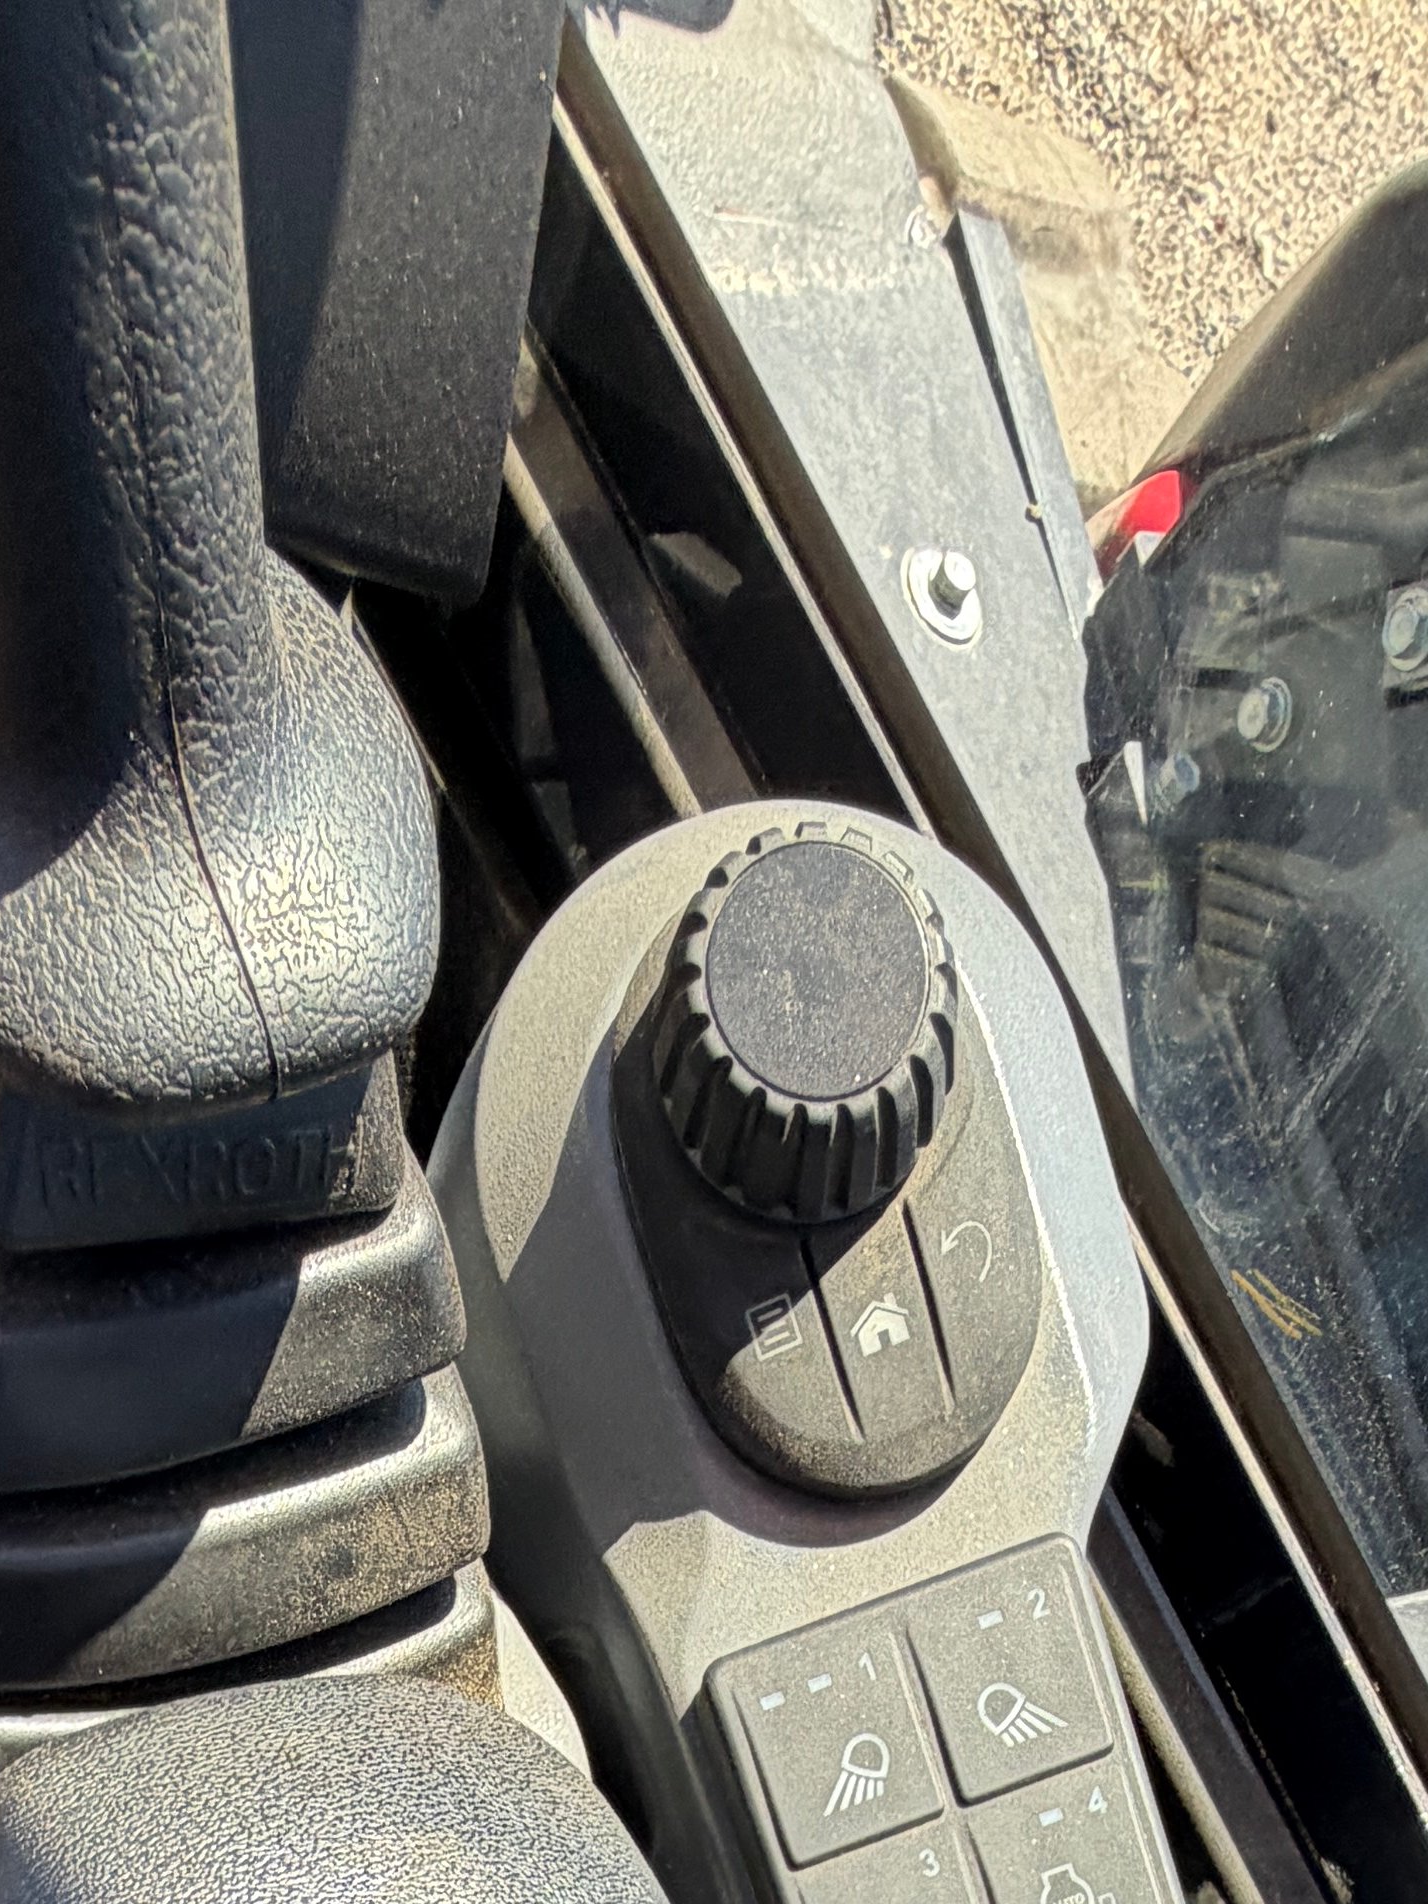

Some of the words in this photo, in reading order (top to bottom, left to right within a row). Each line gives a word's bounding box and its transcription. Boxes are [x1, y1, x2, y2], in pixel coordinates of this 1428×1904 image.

[1028, 1588, 1049, 1620] 2
[858, 1652, 876, 1681] 1
[1088, 1787, 1108, 1815] 4
[919, 1849, 941, 1877] 3
